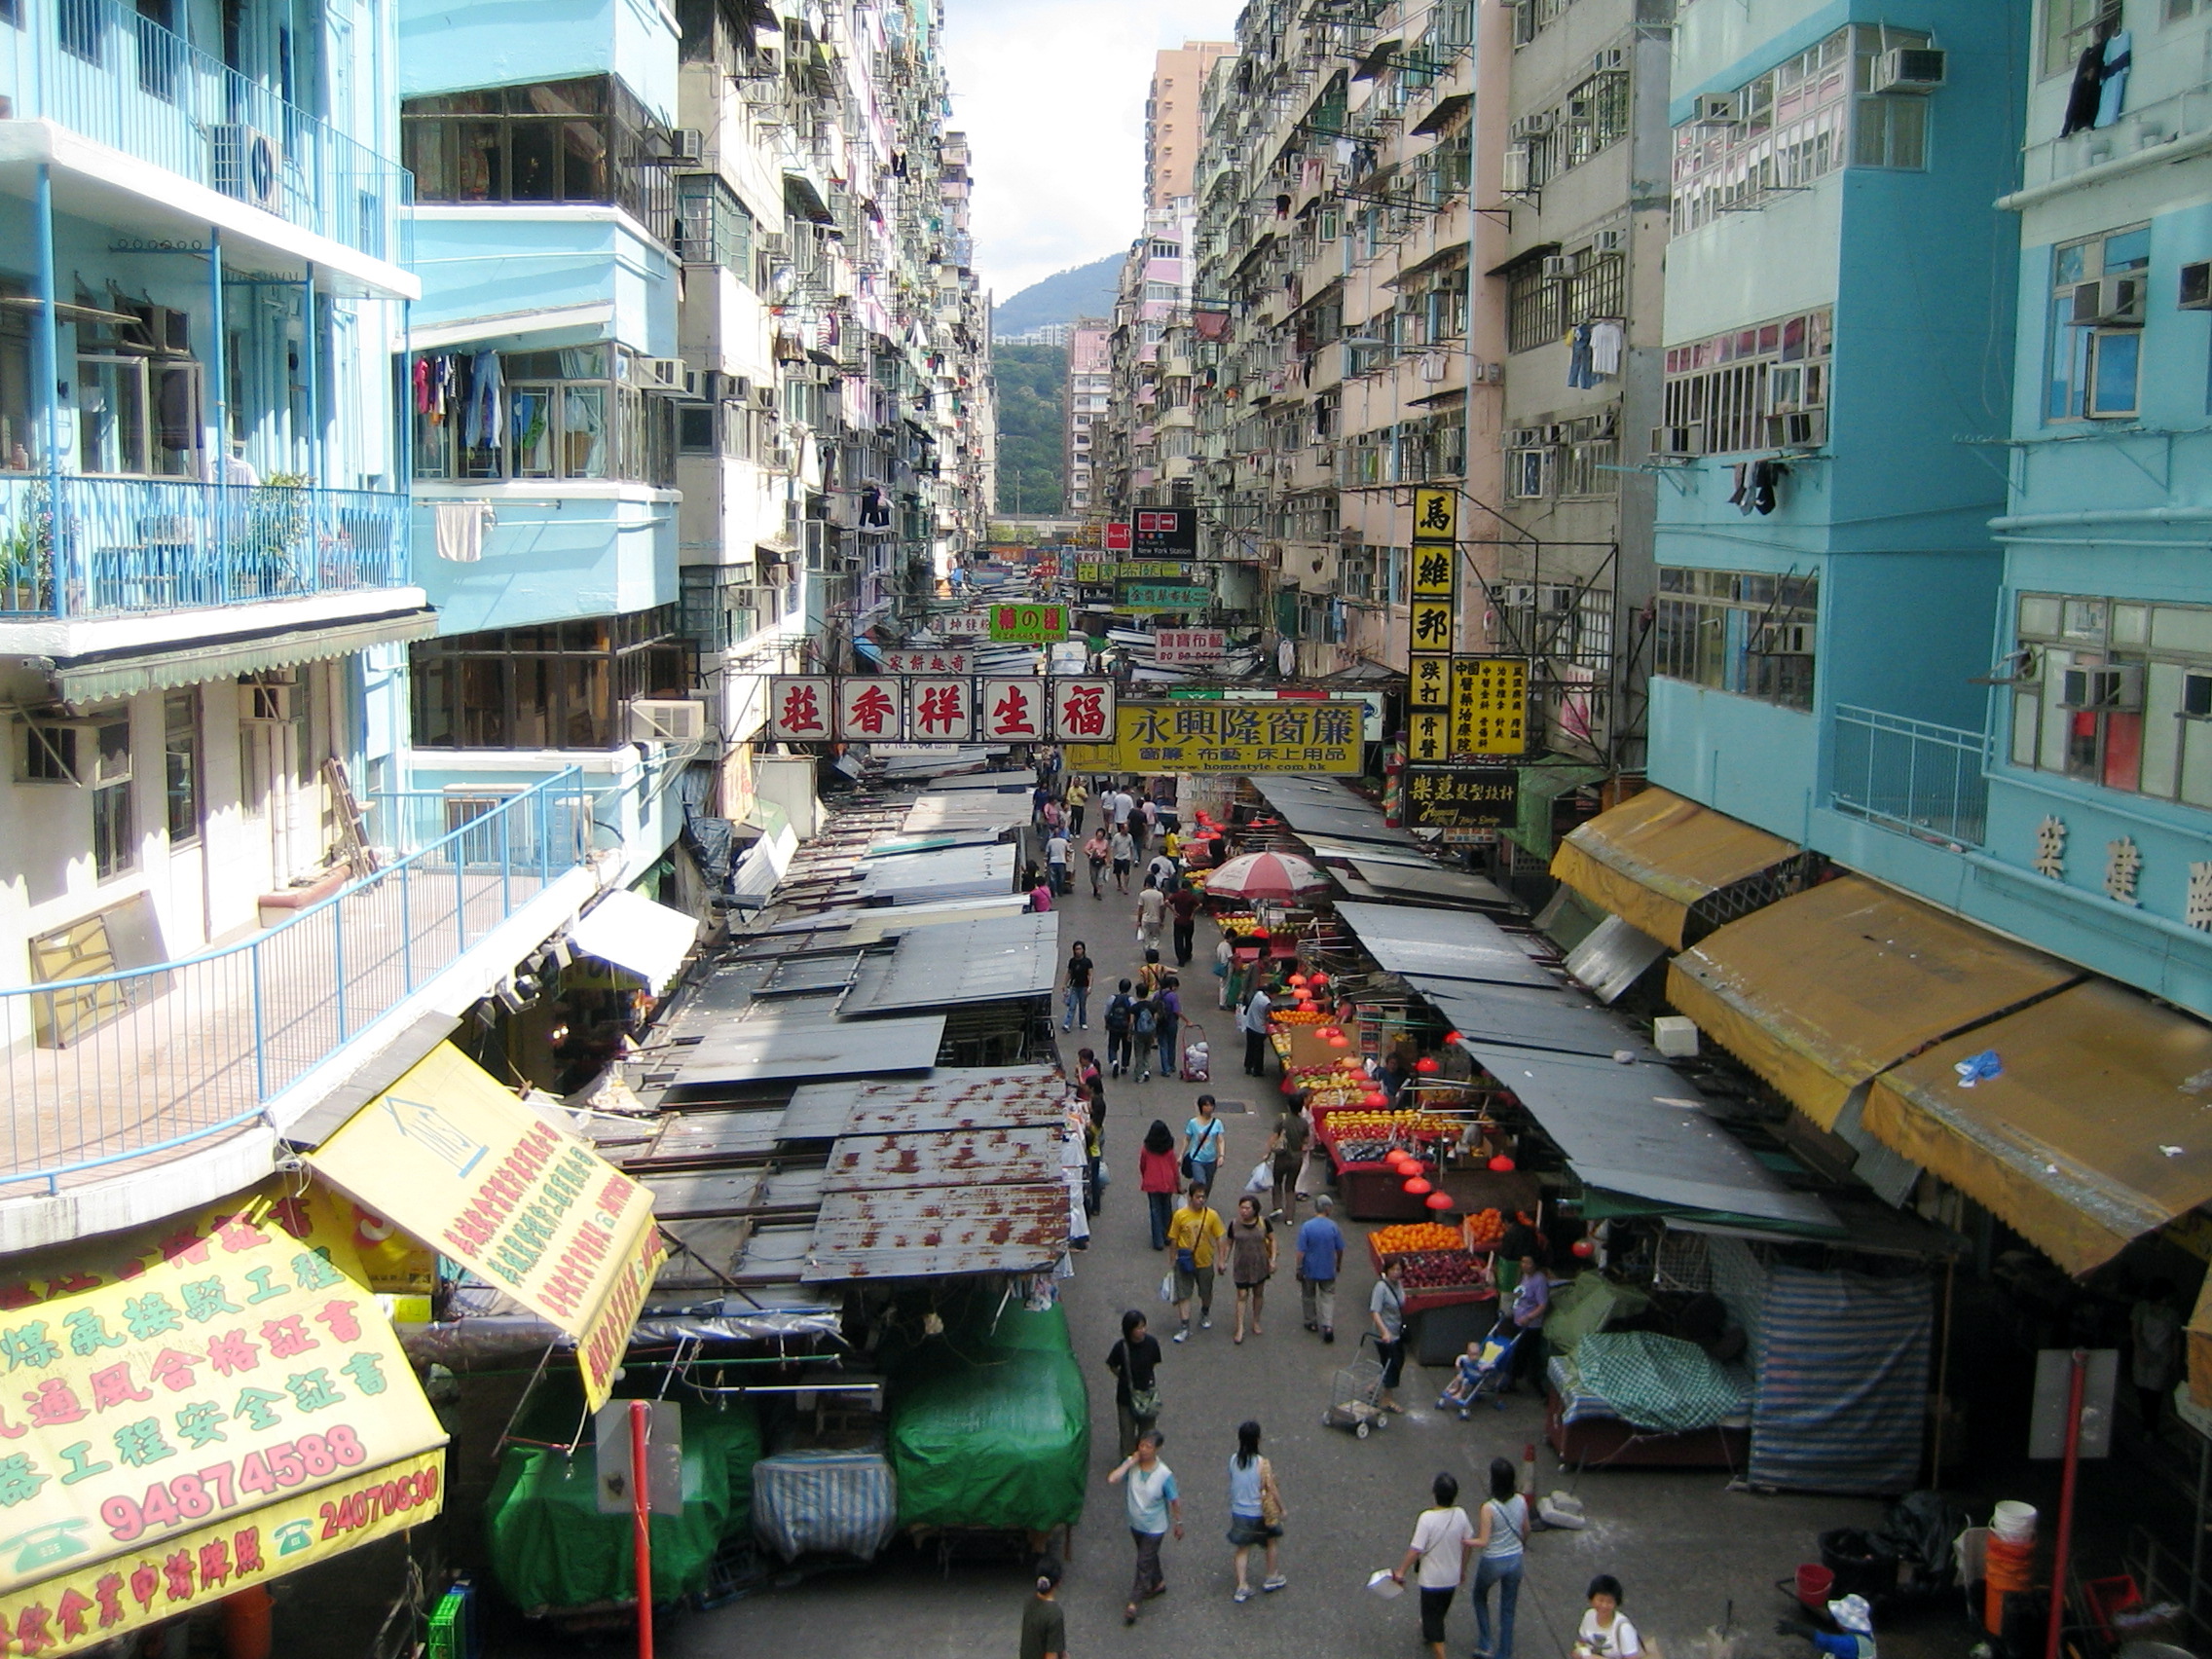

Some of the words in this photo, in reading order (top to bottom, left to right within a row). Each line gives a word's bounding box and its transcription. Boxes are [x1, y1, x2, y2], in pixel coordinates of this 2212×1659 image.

[1417, 496, 1451, 644] 馬維邦
[100, 1423, 366, 1542] 94874588
